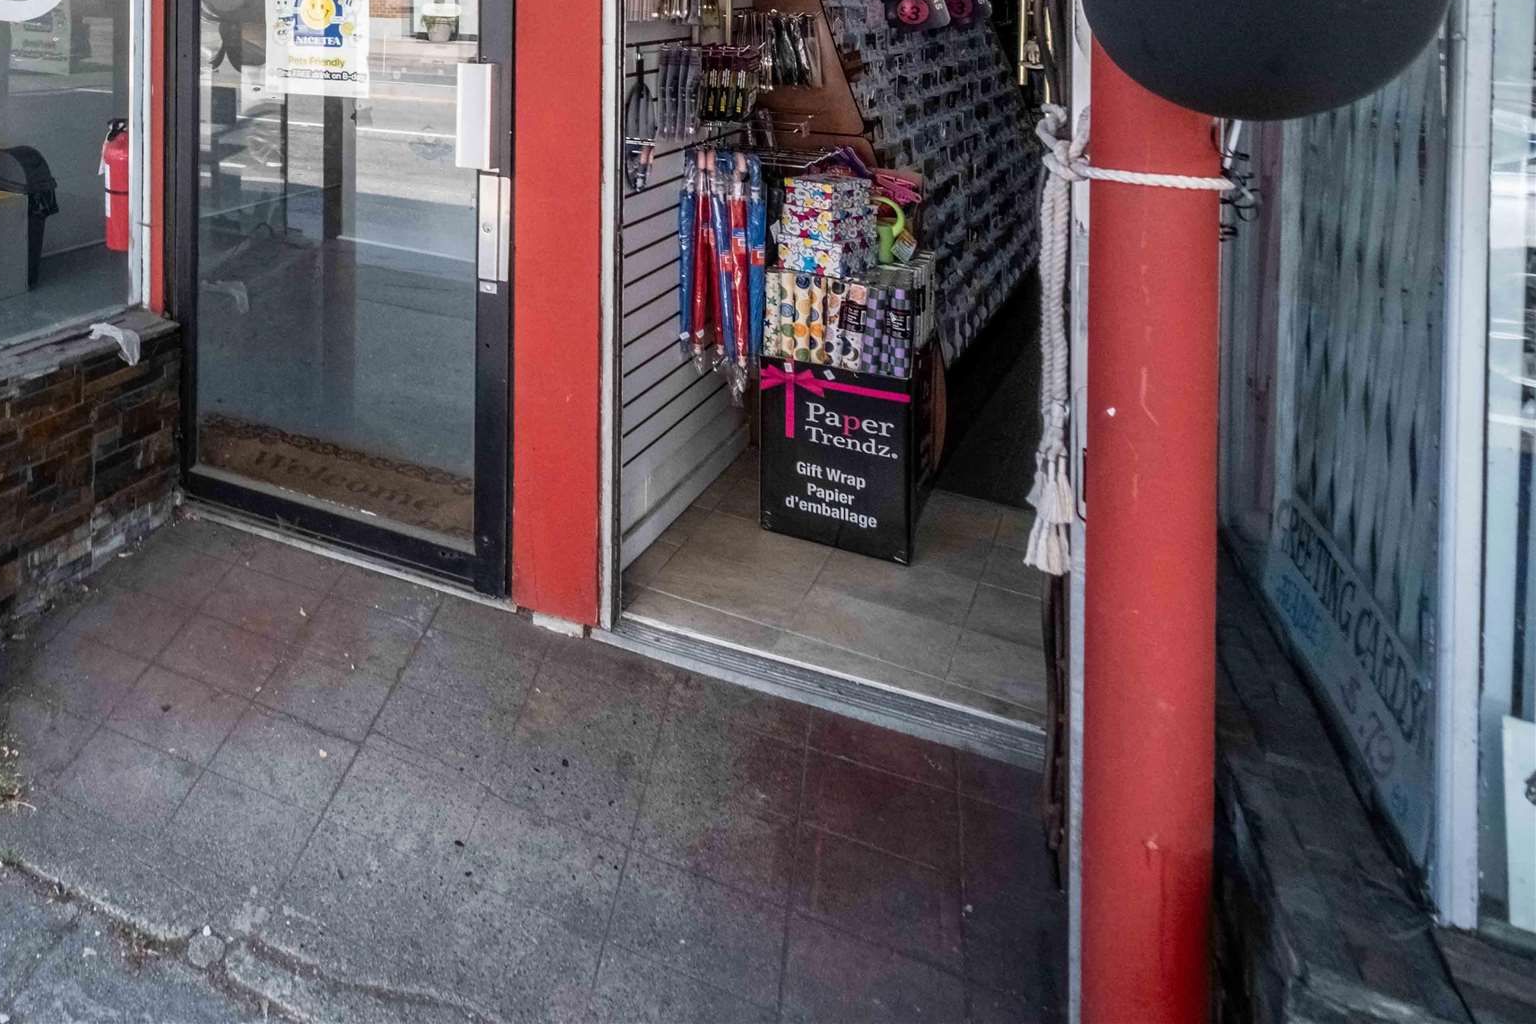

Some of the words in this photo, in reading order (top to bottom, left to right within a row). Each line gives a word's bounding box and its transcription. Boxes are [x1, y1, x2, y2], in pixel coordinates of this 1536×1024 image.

[900, 6, 921, 21] $3
[309, 56, 346, 68] Friendly
[805, 401, 895, 437] Paper
[796, 461, 823, 479] Gift
[825, 467, 866, 490] Wrap
[807, 482, 855, 506] Papier
[785, 495, 878, 529] d'emballage
